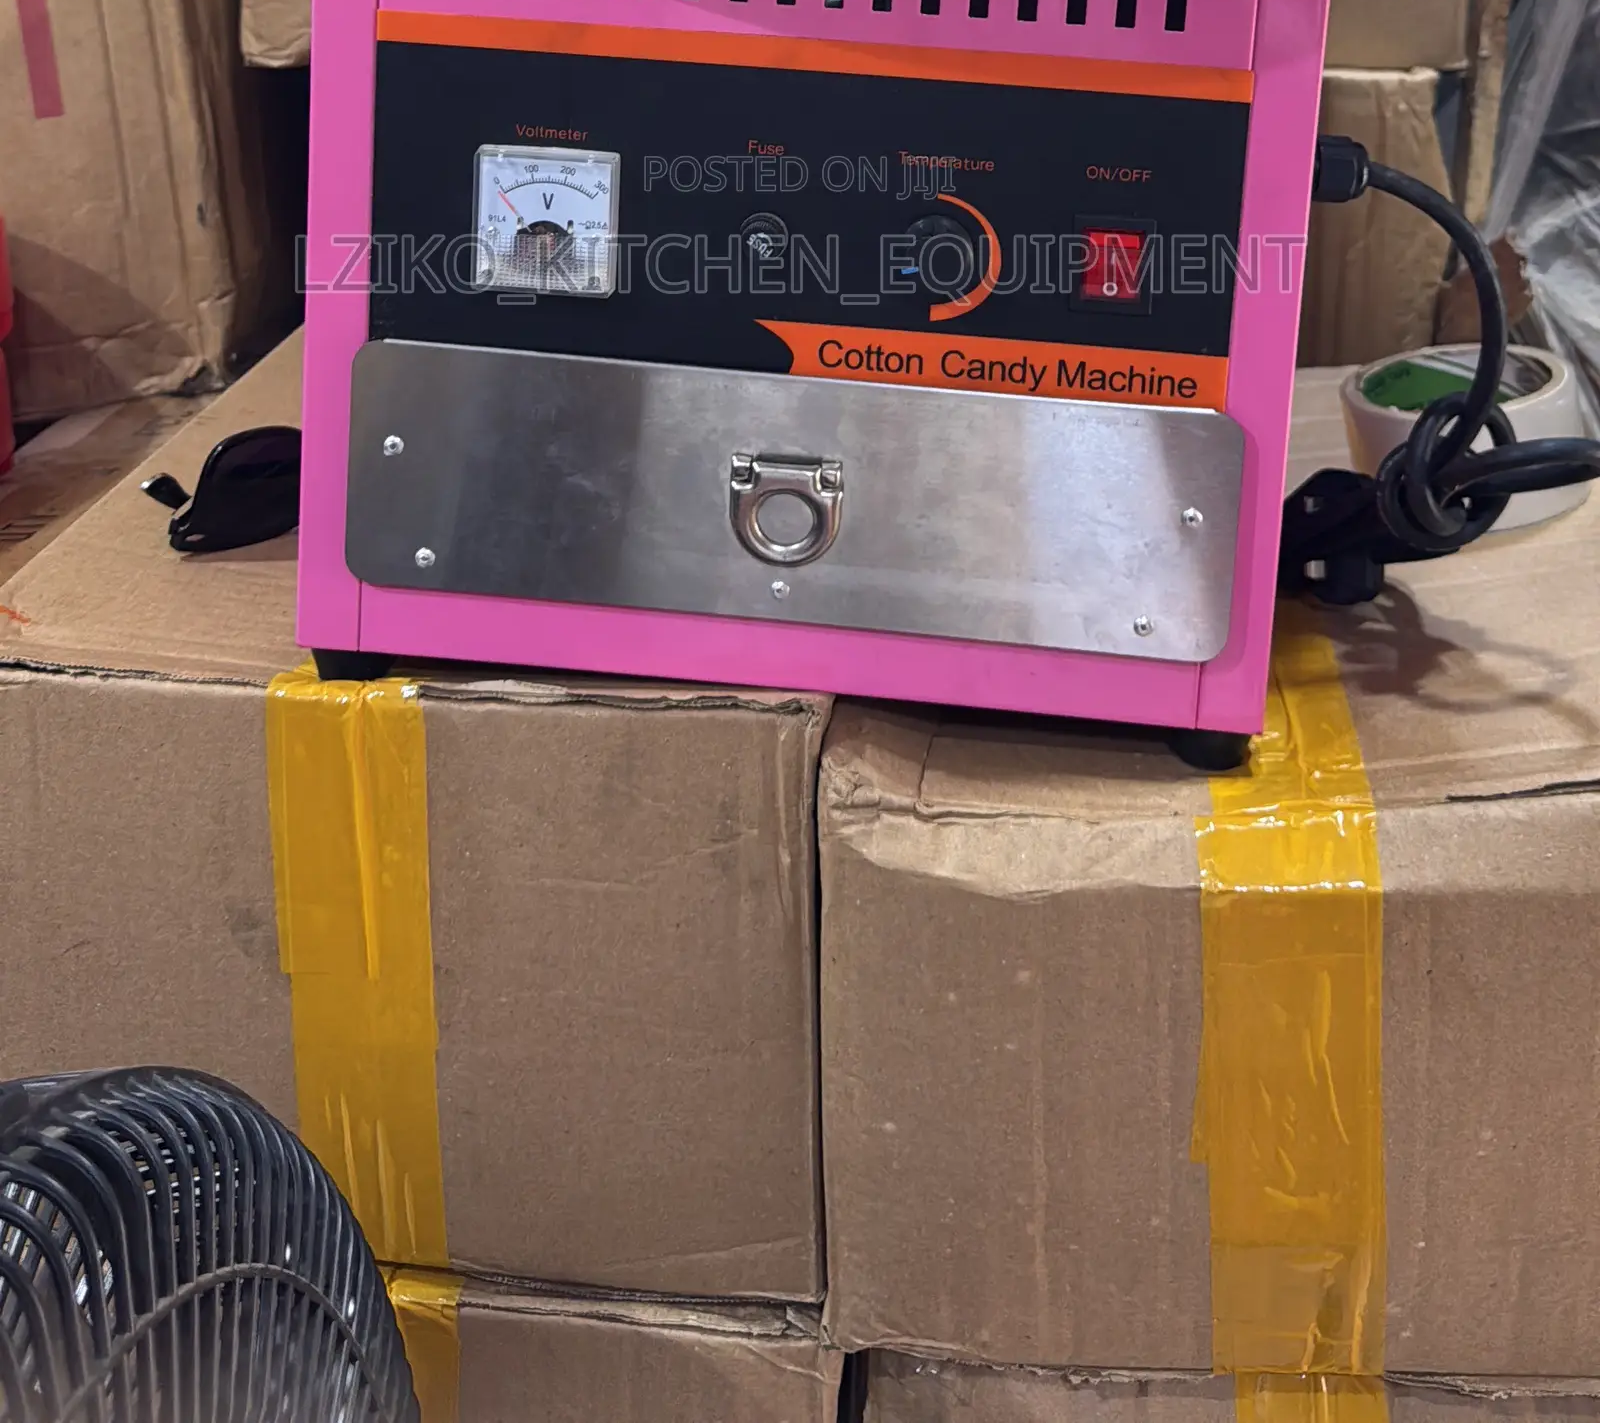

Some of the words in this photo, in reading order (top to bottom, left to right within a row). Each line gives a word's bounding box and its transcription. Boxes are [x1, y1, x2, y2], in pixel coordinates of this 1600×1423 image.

[515, 124, 588, 141] Voltmeter
[749, 140, 785, 156] Fuse
[899, 151, 995, 172] Temperature
[524, 164, 539, 174] 100
[560, 165, 576, 176] 200
[593, 180, 609, 195] 300
[1086, 166, 1152, 182] ON/OFF
[542, 192, 554, 210] V
[488, 214, 506, 223] 91L4
[818, 339, 924, 376] Cotton
[940, 350, 1047, 392] Candy
[1056, 359, 1198, 399] Machine
